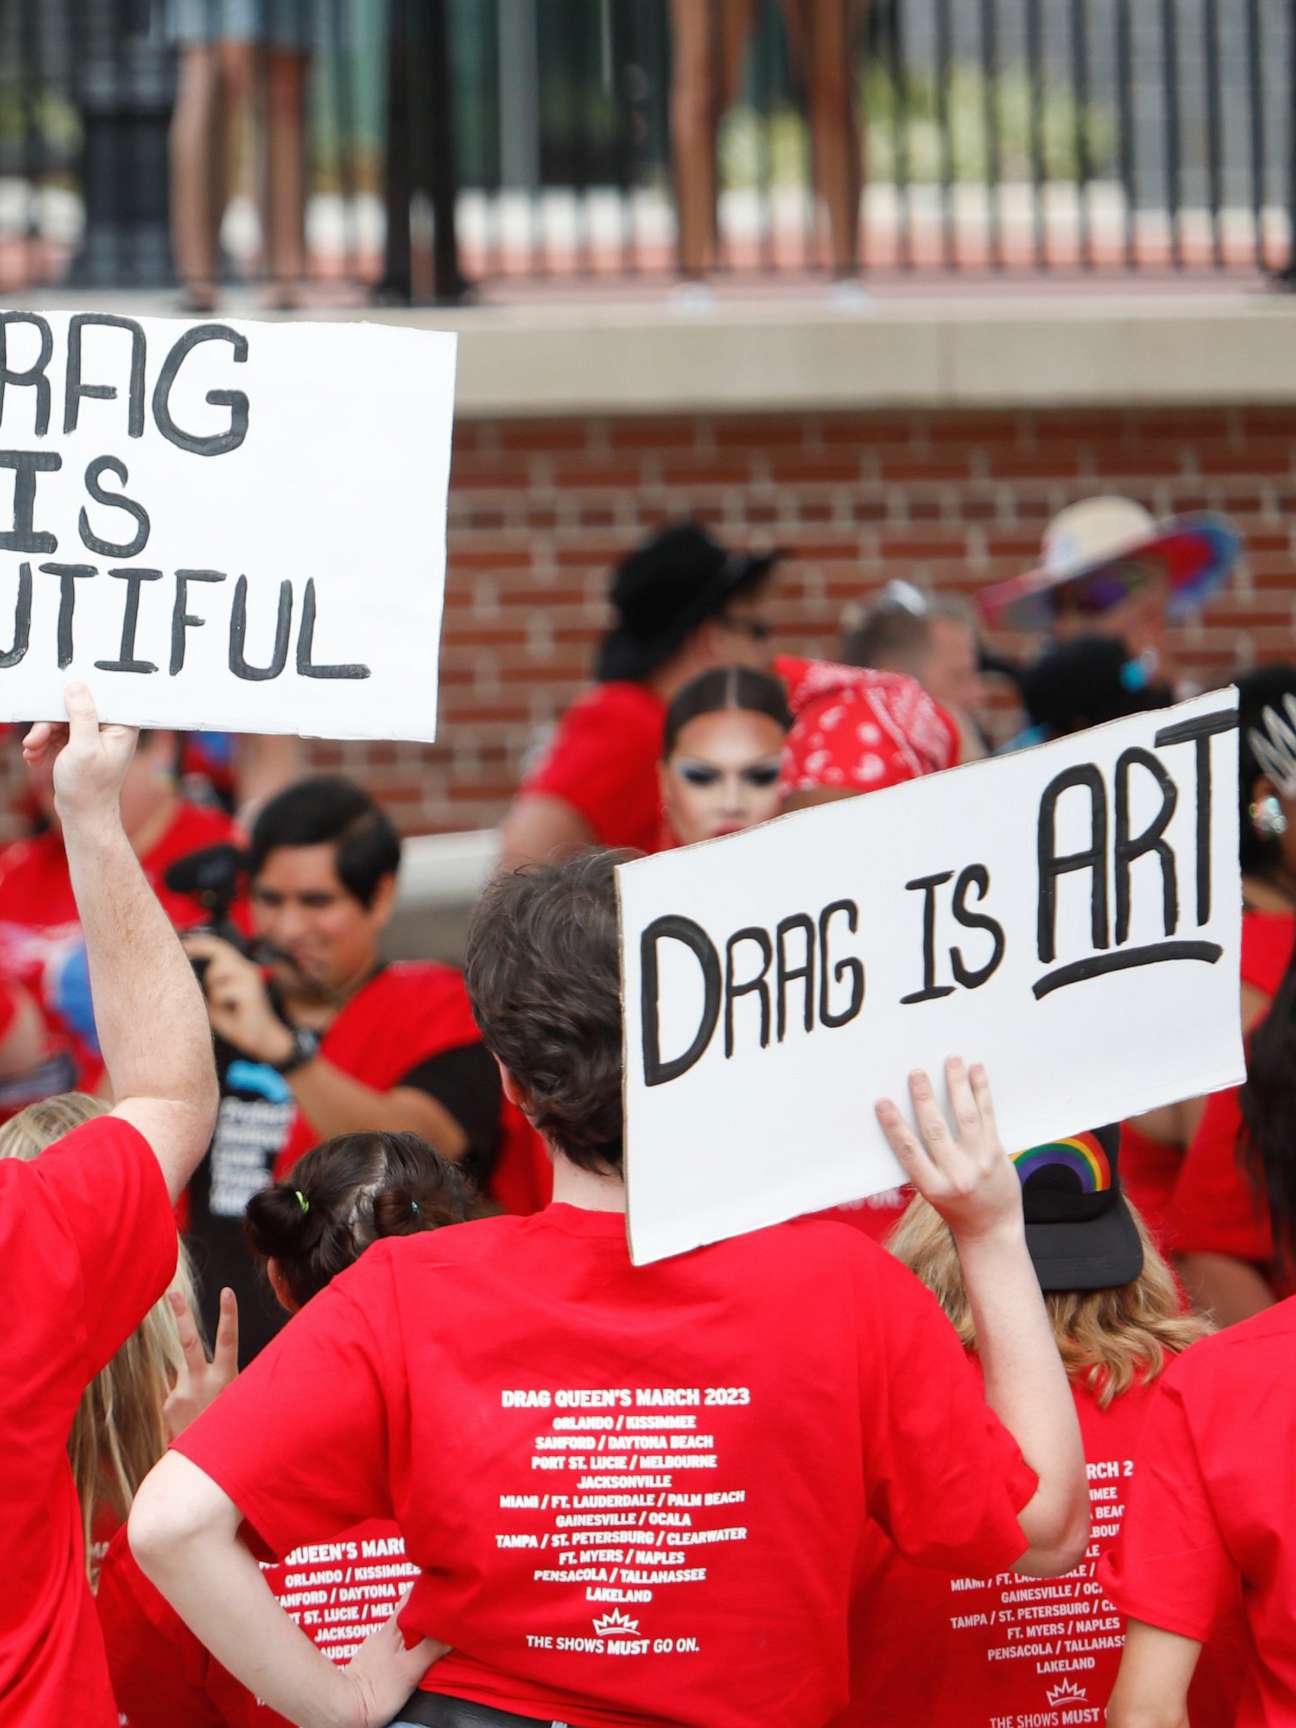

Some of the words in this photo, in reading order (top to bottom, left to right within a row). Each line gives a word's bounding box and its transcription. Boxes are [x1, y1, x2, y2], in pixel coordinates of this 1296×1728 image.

[641, 900, 864, 1087] DRAG
[901, 864, 1004, 1004] IS
[1037, 708, 1239, 963] ART
[501, 1390, 551, 1407] DRAG
[554, 1388, 631, 1407] QUEEN'S
[635, 1388, 699, 1406] MARCH
[704, 1387, 750, 1405] 2023
[552, 1416, 614, 1430] ORLANDO
[625, 1415, 696, 1429] KISSIMMEE
[535, 1436, 596, 1449] SANFORD
[607, 1435, 667, 1449] DAYTONA
[670, 1435, 713, 1448] BEACH
[531, 1455, 566, 1469] PORT
[568, 1455, 587, 1469] ST.
[590, 1455, 627, 1469] LUCIE
[639, 1454, 717, 1468] MELBOURNE
[1086, 1461, 1120, 1480] RCH
[576, 1474, 671, 1489] JACKSONVILLE
[499, 1495, 539, 1508] MIAMI
[551, 1495, 570, 1508] FT.
[572, 1493, 655, 1508] LAUDERDALE
[667, 1493, 702, 1506] PALM
[704, 1490, 745, 1505] BEACH
[555, 1512, 636, 1527] GAINESVILLE
[648, 1512, 691, 1526] OCALA
[495, 1534, 538, 1547] TAMPA
[551, 1533, 569, 1547] ST.
[571, 1530, 654, 1545] PETERSBURG
[666, 1527, 746, 1545] CLEARWATER
[559, 1551, 577, 1565] FT.
[579, 1549, 623, 1563] MYERS
[635, 1550, 684, 1564] NAPLES
[284, 1569, 342, 1587] ORLANDO
[533, 1567, 607, 1582] PENSACOLA
[619, 1567, 706, 1583] TALLAHASSEE
[995, 1572, 1013, 1586] FT.
[275, 1590, 327, 1608] ANFORD
[338, 1583, 396, 1601] DAYTONA
[585, 1587, 652, 1602] LAKELAND
[1001, 1584, 1072, 1603] GAINESVILLE
[303, 1609, 322, 1624] ST.
[323, 1605, 359, 1622] LUCIE
[950, 1613, 987, 1628] TAMPA
[998, 1609, 1014, 1622] ST.
[1017, 1601, 1090, 1619] PETERSBURG
[1007, 1626, 1023, 1639] FT.
[1026, 1622, 1064, 1637] MYERS
[1075, 1616, 1120, 1632] NAPLES
[526, 1635, 552, 1648] THE
[556, 1634, 604, 1653] SHOWS
[606, 1639, 650, 1655] MUST
[653, 1638, 673, 1653] GO
[675, 1637, 699, 1652] ON.
[987, 1642, 1053, 1660] PENSACOLA
[1036, 1656, 1095, 1673] LAKELAND
[989, 1715, 1014, 1728] THE
[1016, 1711, 1059, 1728] SHOWS
[1062, 1707, 1100, 1725] MUST
